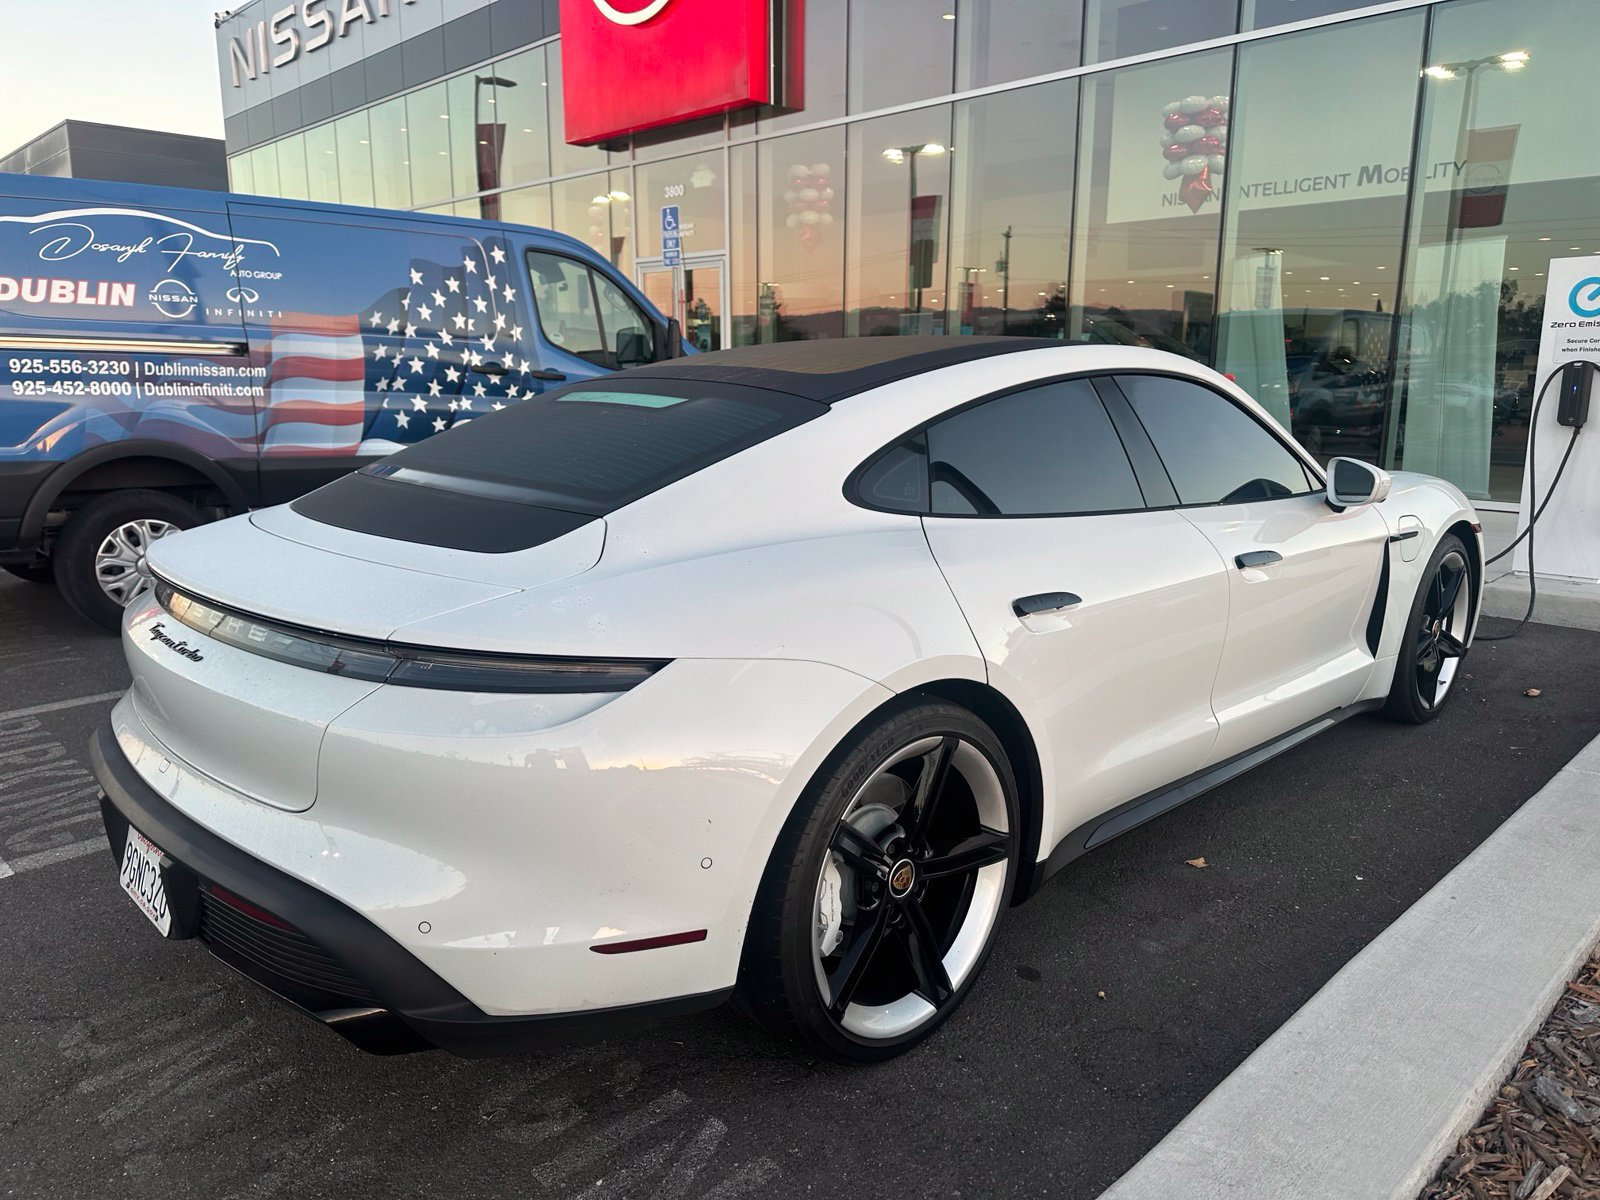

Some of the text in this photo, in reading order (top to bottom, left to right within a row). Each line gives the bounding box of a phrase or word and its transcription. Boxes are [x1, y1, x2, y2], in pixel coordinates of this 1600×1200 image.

[229, 0, 416, 88] NISSA
[664, 184, 684, 198] 3800
[1239, 173, 1351, 200] NTELLIGENT
[230, 270, 282, 280] AUTO GROUP
[0, 276, 136, 307] DUBLIN
[149, 293, 198, 303] NISSAN
[205, 307, 282, 318] INFINITI
[9, 359, 130, 375] 925-556-3230
[144, 362, 267, 378] Dublinnissan.com
[12, 381, 132, 396] 925-452-8000
[145, 384, 264, 398] Dublininfiniti.com
